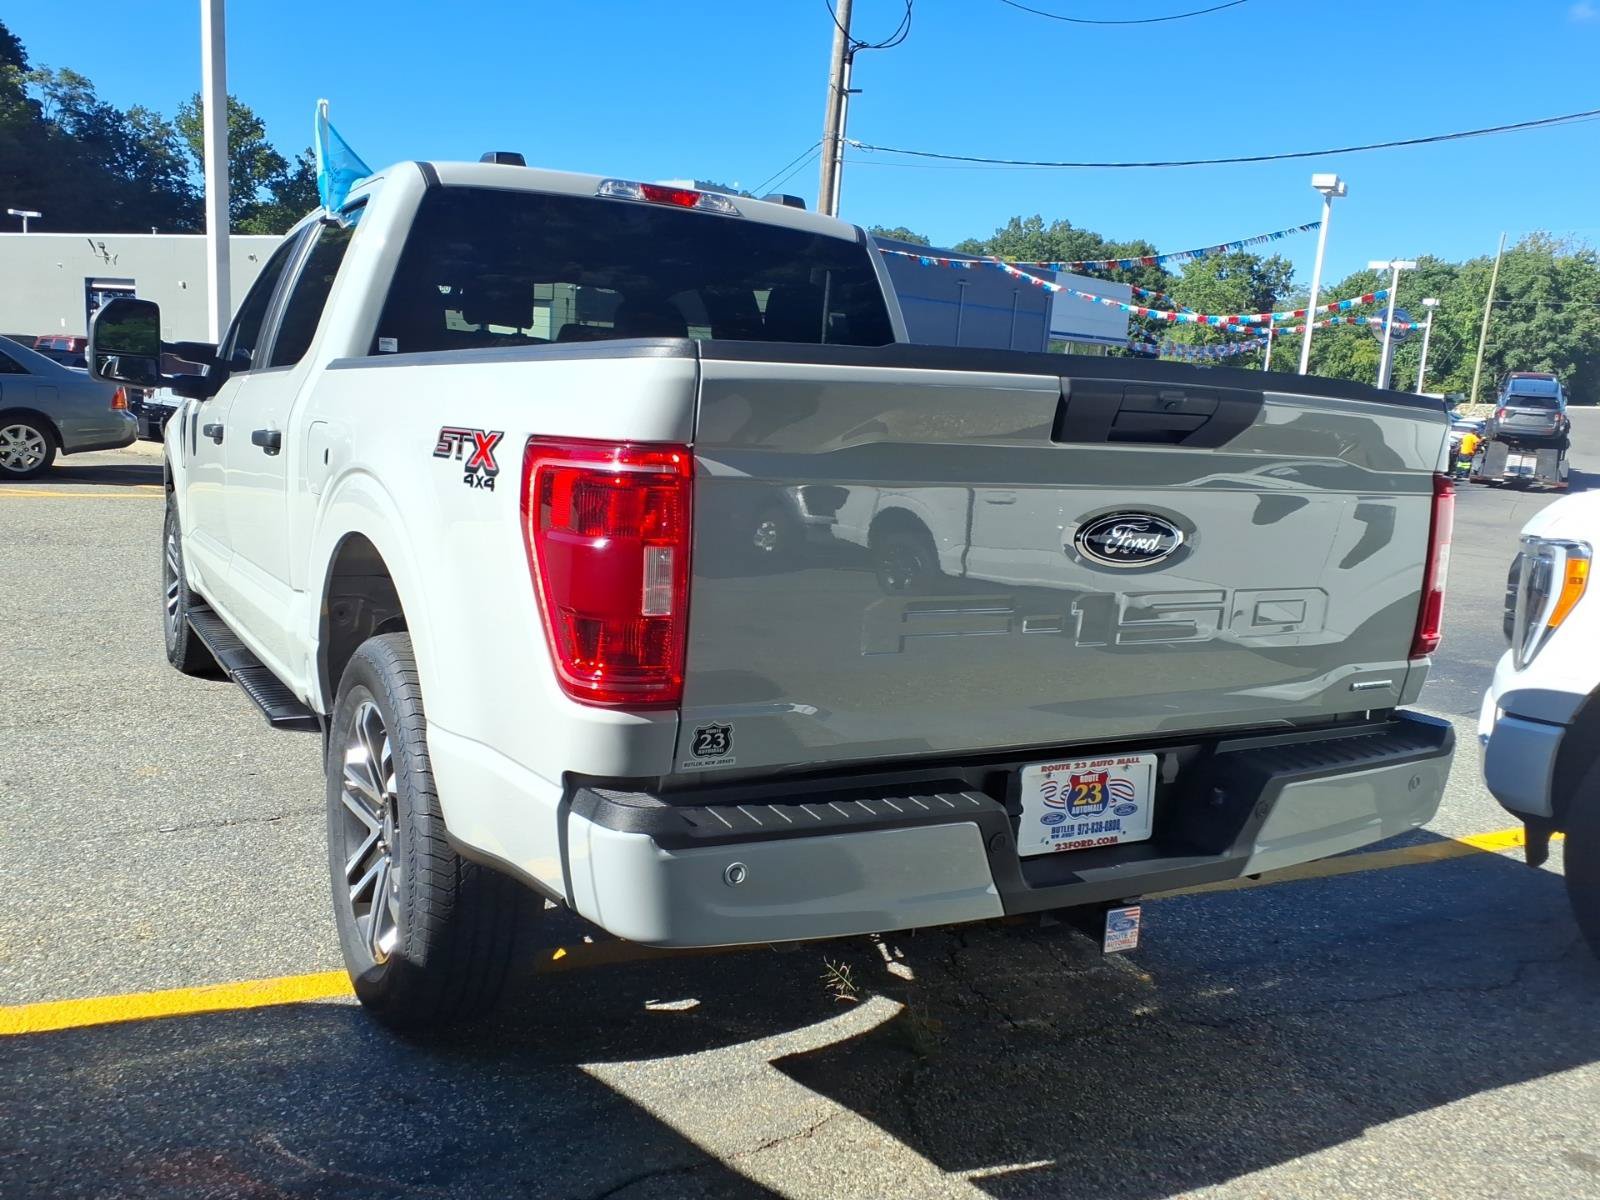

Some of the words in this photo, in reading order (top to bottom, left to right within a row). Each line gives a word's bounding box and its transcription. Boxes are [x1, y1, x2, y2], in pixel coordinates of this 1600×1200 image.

[433, 426, 504, 477] STX
[1104, 524, 1161, 554] Ford
[861, 587, 1329, 656] F-150
[699, 733, 725, 749] 23
[1041, 763, 1071, 773] ROUTE
[1074, 761, 1087, 769] 23
[1089, 759, 1114, 768] AUTO
[1116, 757, 1141, 766] MALL
[1080, 773, 1099, 783] ROUTE
[1073, 783, 1102, 805] 23
[1071, 803, 1103, 815] AUTOMALL
[1051, 825, 1075, 834] BUTLER
[1054, 836, 1118, 850] 23FORD.COM
